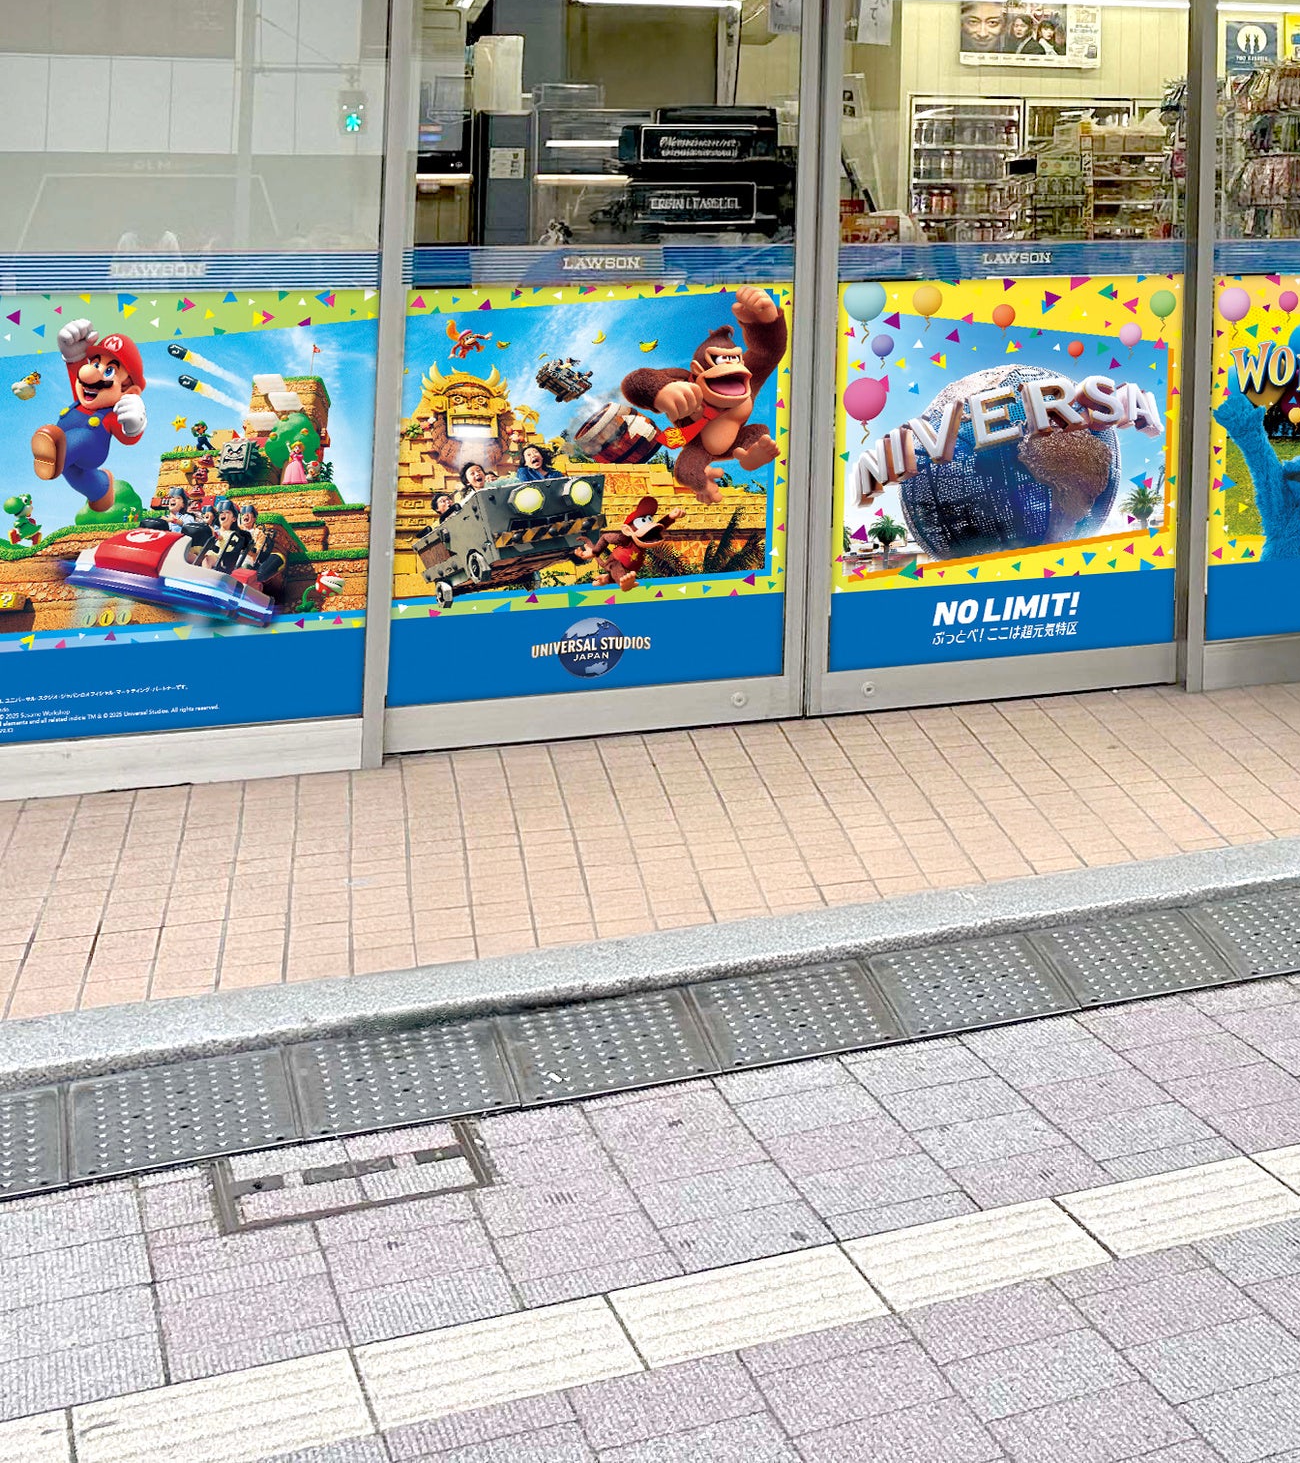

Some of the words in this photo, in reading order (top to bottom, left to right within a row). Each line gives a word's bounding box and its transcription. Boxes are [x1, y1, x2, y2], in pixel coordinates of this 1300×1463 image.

[563, 256, 641, 270] LAWSON
[982, 252, 1051, 264] LAWSON
[933, 599, 979, 627] NO
[983, 591, 1080, 623] LIMIT!
[531, 636, 598, 659] UNIVERSAL
[600, 635, 651, 652] STUDIOS
[573, 651, 610, 662] JAPAN
